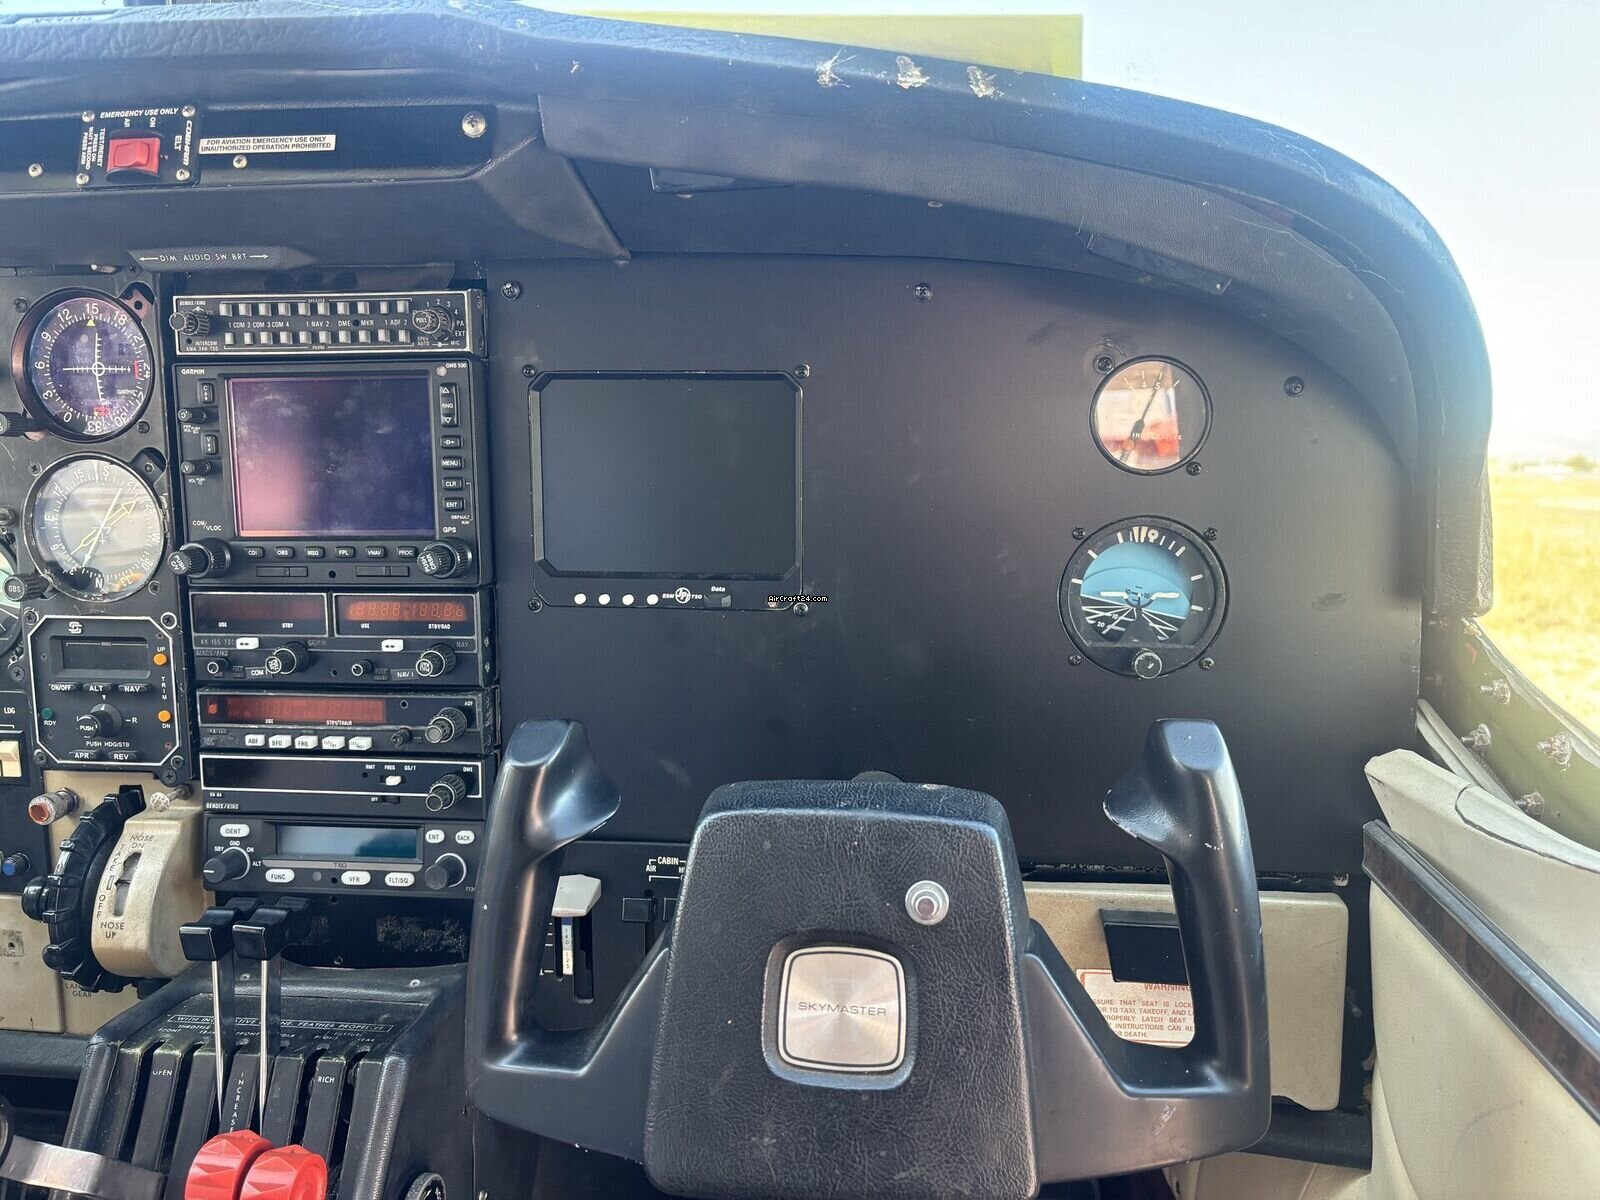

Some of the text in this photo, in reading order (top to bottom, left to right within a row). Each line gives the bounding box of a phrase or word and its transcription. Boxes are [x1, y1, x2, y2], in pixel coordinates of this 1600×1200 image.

[100, 110, 144, 118] EMERGENCY
[150, 117, 156, 128] ON
[57, 308, 73, 322] 12
[85, 304, 99, 315] 15
[113, 310, 128, 325] 18
[41, 331, 51, 341] 9
[133, 334, 146, 347] 21
[34, 361, 45, 370] 6
[42, 390, 53, 400] 3
[115, 413, 128, 427] 30
[88, 421, 102, 432] 33
[74, 470, 85, 480] 15
[103, 466, 110, 476] S
[192, 520, 222, 531] COM/VLOC
[152, 533, 160, 543] W
[142, 559, 153, 571] 30
[95, 578, 103, 588] N
[120, 576, 133, 587] 33
[658, 856, 678, 865] CABIN
[100, 922, 125, 930] NOSE
[798, 1002, 886, 1016] SKYMASTER
[230, 1072, 244, 1133] INCREASE
